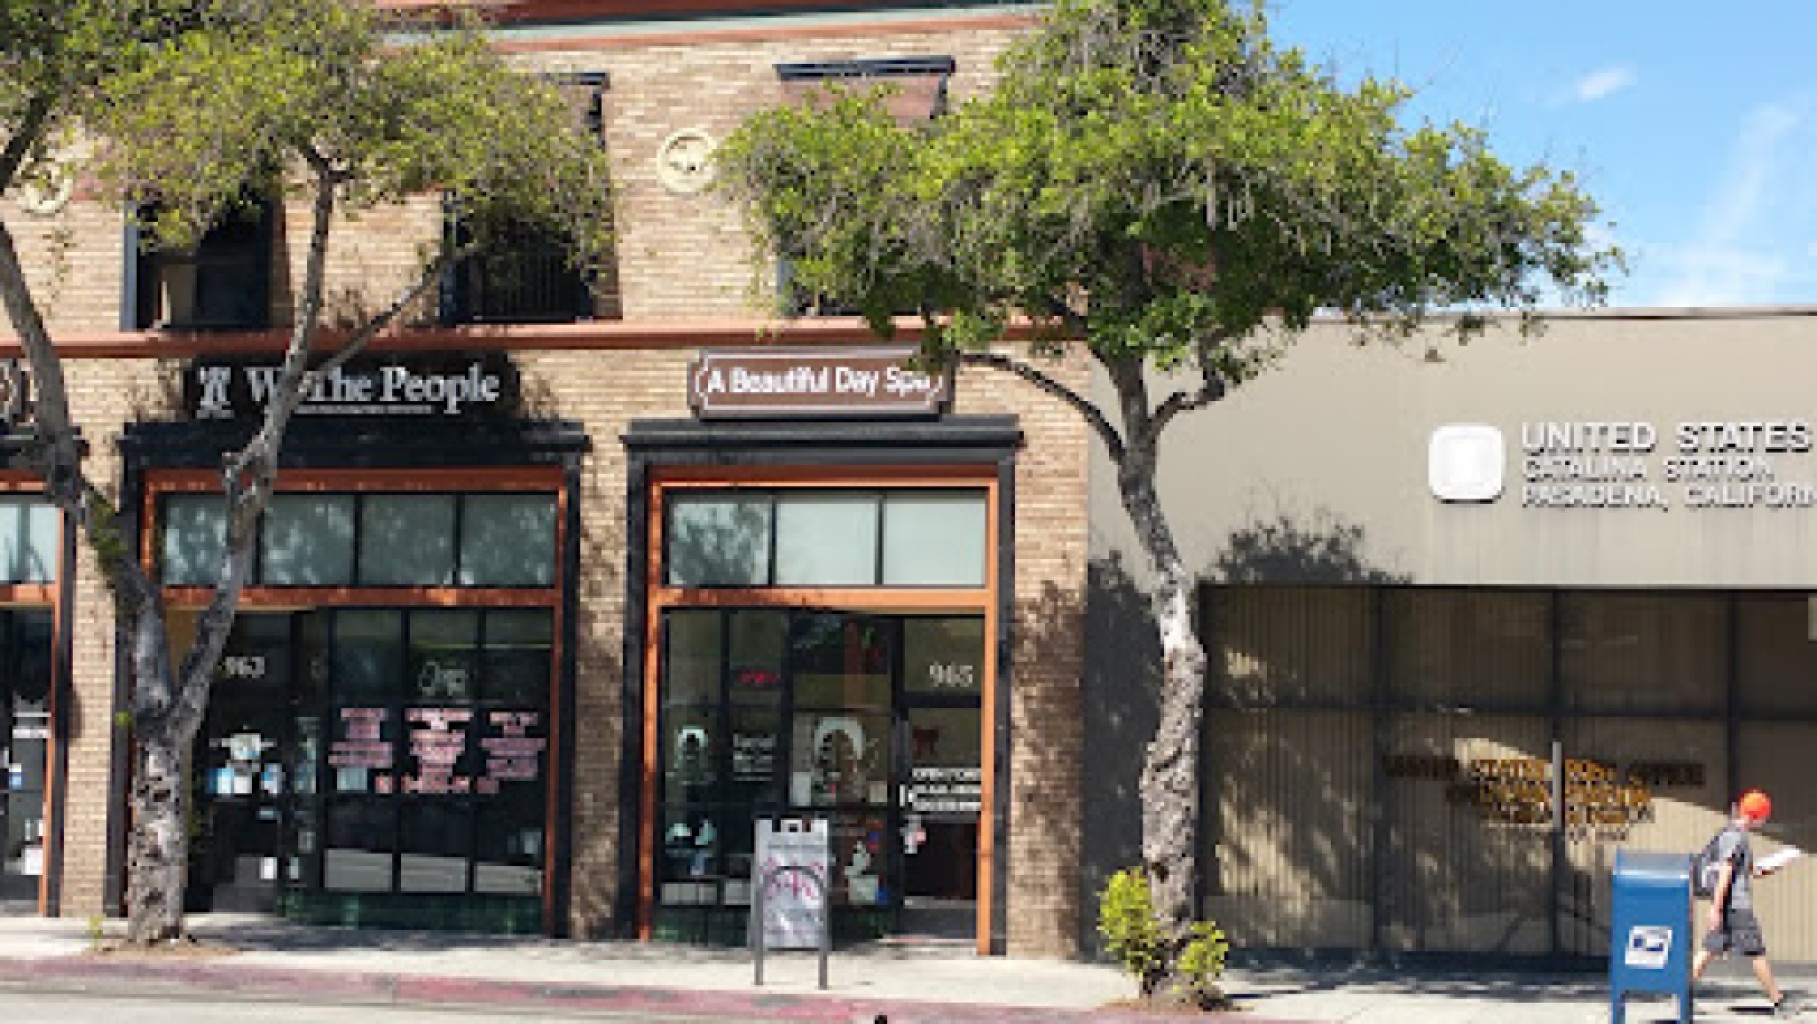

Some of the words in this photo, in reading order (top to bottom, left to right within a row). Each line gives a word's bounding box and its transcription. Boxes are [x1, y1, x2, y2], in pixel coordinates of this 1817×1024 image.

[379, 362, 500, 414] People
[707, 369, 725, 393] A
[729, 367, 829, 393] Beautiful
[835, 367, 879, 398] Day
[1521, 421, 1657, 454] UNITED
[1676, 421, 1812, 453] STATES
[929, 662, 974, 687] 965
